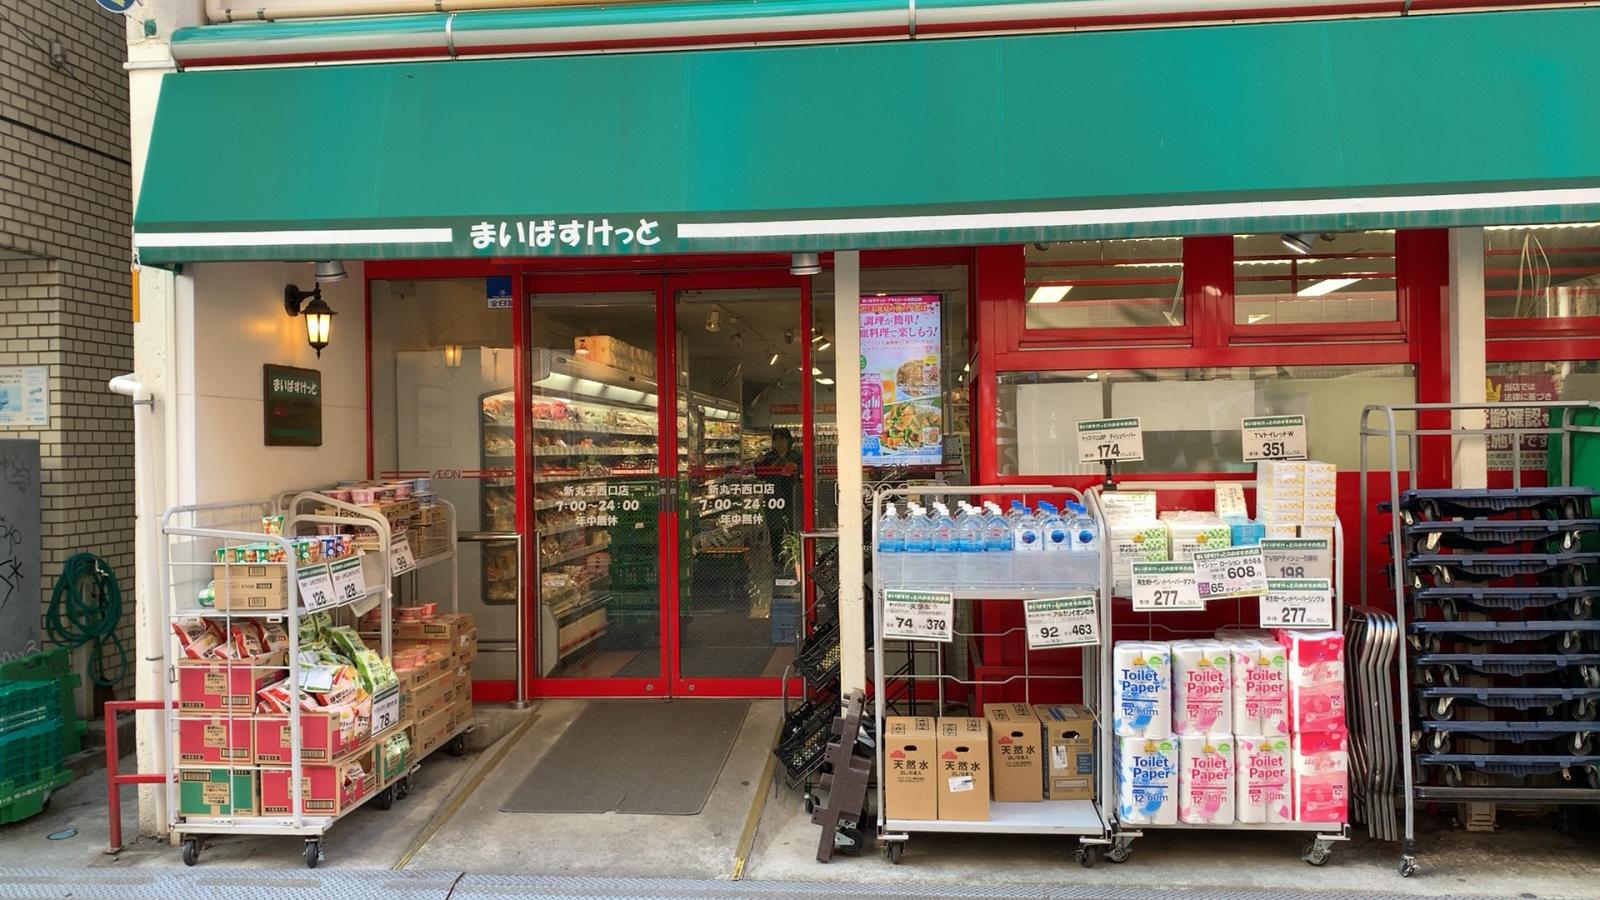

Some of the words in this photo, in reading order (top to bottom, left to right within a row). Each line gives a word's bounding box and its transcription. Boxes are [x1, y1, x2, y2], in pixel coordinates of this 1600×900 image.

[469, 218, 661, 249] まいばすけっと
[273, 378, 318, 396] まいばすけっと
[1503, 382, 1536, 392] 当店では
[1097, 443, 1120, 458] 174
[1262, 442, 1285, 456] 351
[563, 485, 630, 497] 新丸子西口店
[708, 483, 775, 495] 新丸子西口店
[575, 515, 618, 527] 年中無休
[720, 514, 764, 525] 年中無休
[1227, 566, 1256, 579] 608
[1280, 566, 1305, 578] 198
[344, 583, 357, 599] 128
[1210, 582, 1225, 593] 65
[312, 590, 327, 607] 128
[1154, 590, 1178, 605] 277
[1281, 607, 1306, 623] 277
[895, 616, 914, 629] 74
[926, 619, 946, 631] 370
[1040, 626, 1059, 639] 92
[1071, 623, 1092, 636] 463
[1121, 669, 1159, 681] Toilet
[1186, 671, 1224, 682] Toilet
[1246, 670, 1282, 681] Toilet
[1122, 681, 1161, 694] Paper
[1187, 682, 1225, 695] Paper
[1246, 681, 1283, 694] Paper
[379, 713, 390, 729] 78
[1001, 745, 1036, 755] 天然水
[893, 760, 929, 770] 天然水
[945, 760, 981, 771] 天然水
[1132, 756, 1169, 767] Toilet
[1191, 757, 1228, 769] Toilet
[1248, 756, 1284, 767] Toilet
[1133, 767, 1171, 780] Paper
[1191, 768, 1229, 782] Paper
[1249, 767, 1285, 780] Paper
